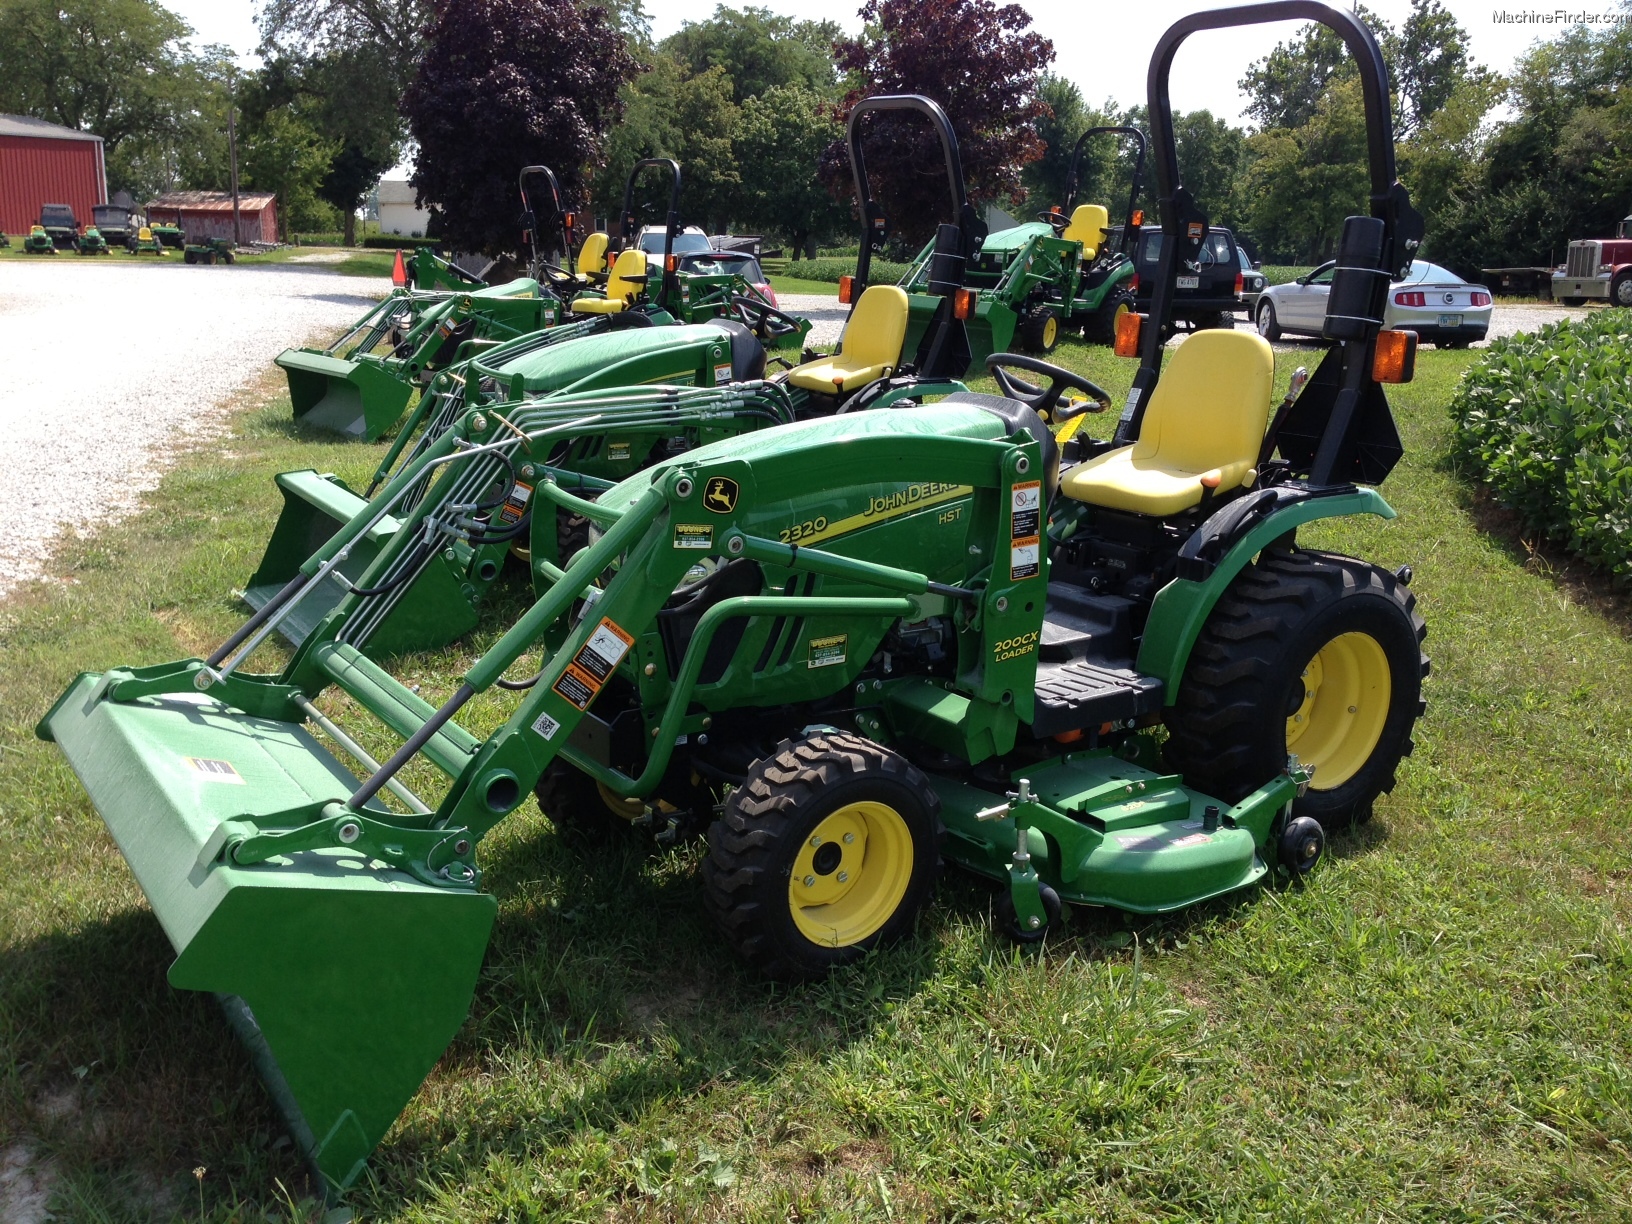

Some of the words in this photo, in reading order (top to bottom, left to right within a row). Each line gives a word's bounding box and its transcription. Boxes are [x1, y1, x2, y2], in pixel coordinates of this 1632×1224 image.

[1017, 481, 1040, 489] WARNING
[864, 489, 907, 516] JOHN
[938, 507, 962, 525] HST
[779, 515, 828, 544] 2320
[1017, 538, 1039, 547] WARNING
[610, 623, 631, 643] WARNING
[993, 630, 1039, 653] 200CX
[995, 643, 1034, 662] LOADER
[575, 671, 596, 690] WARNING
